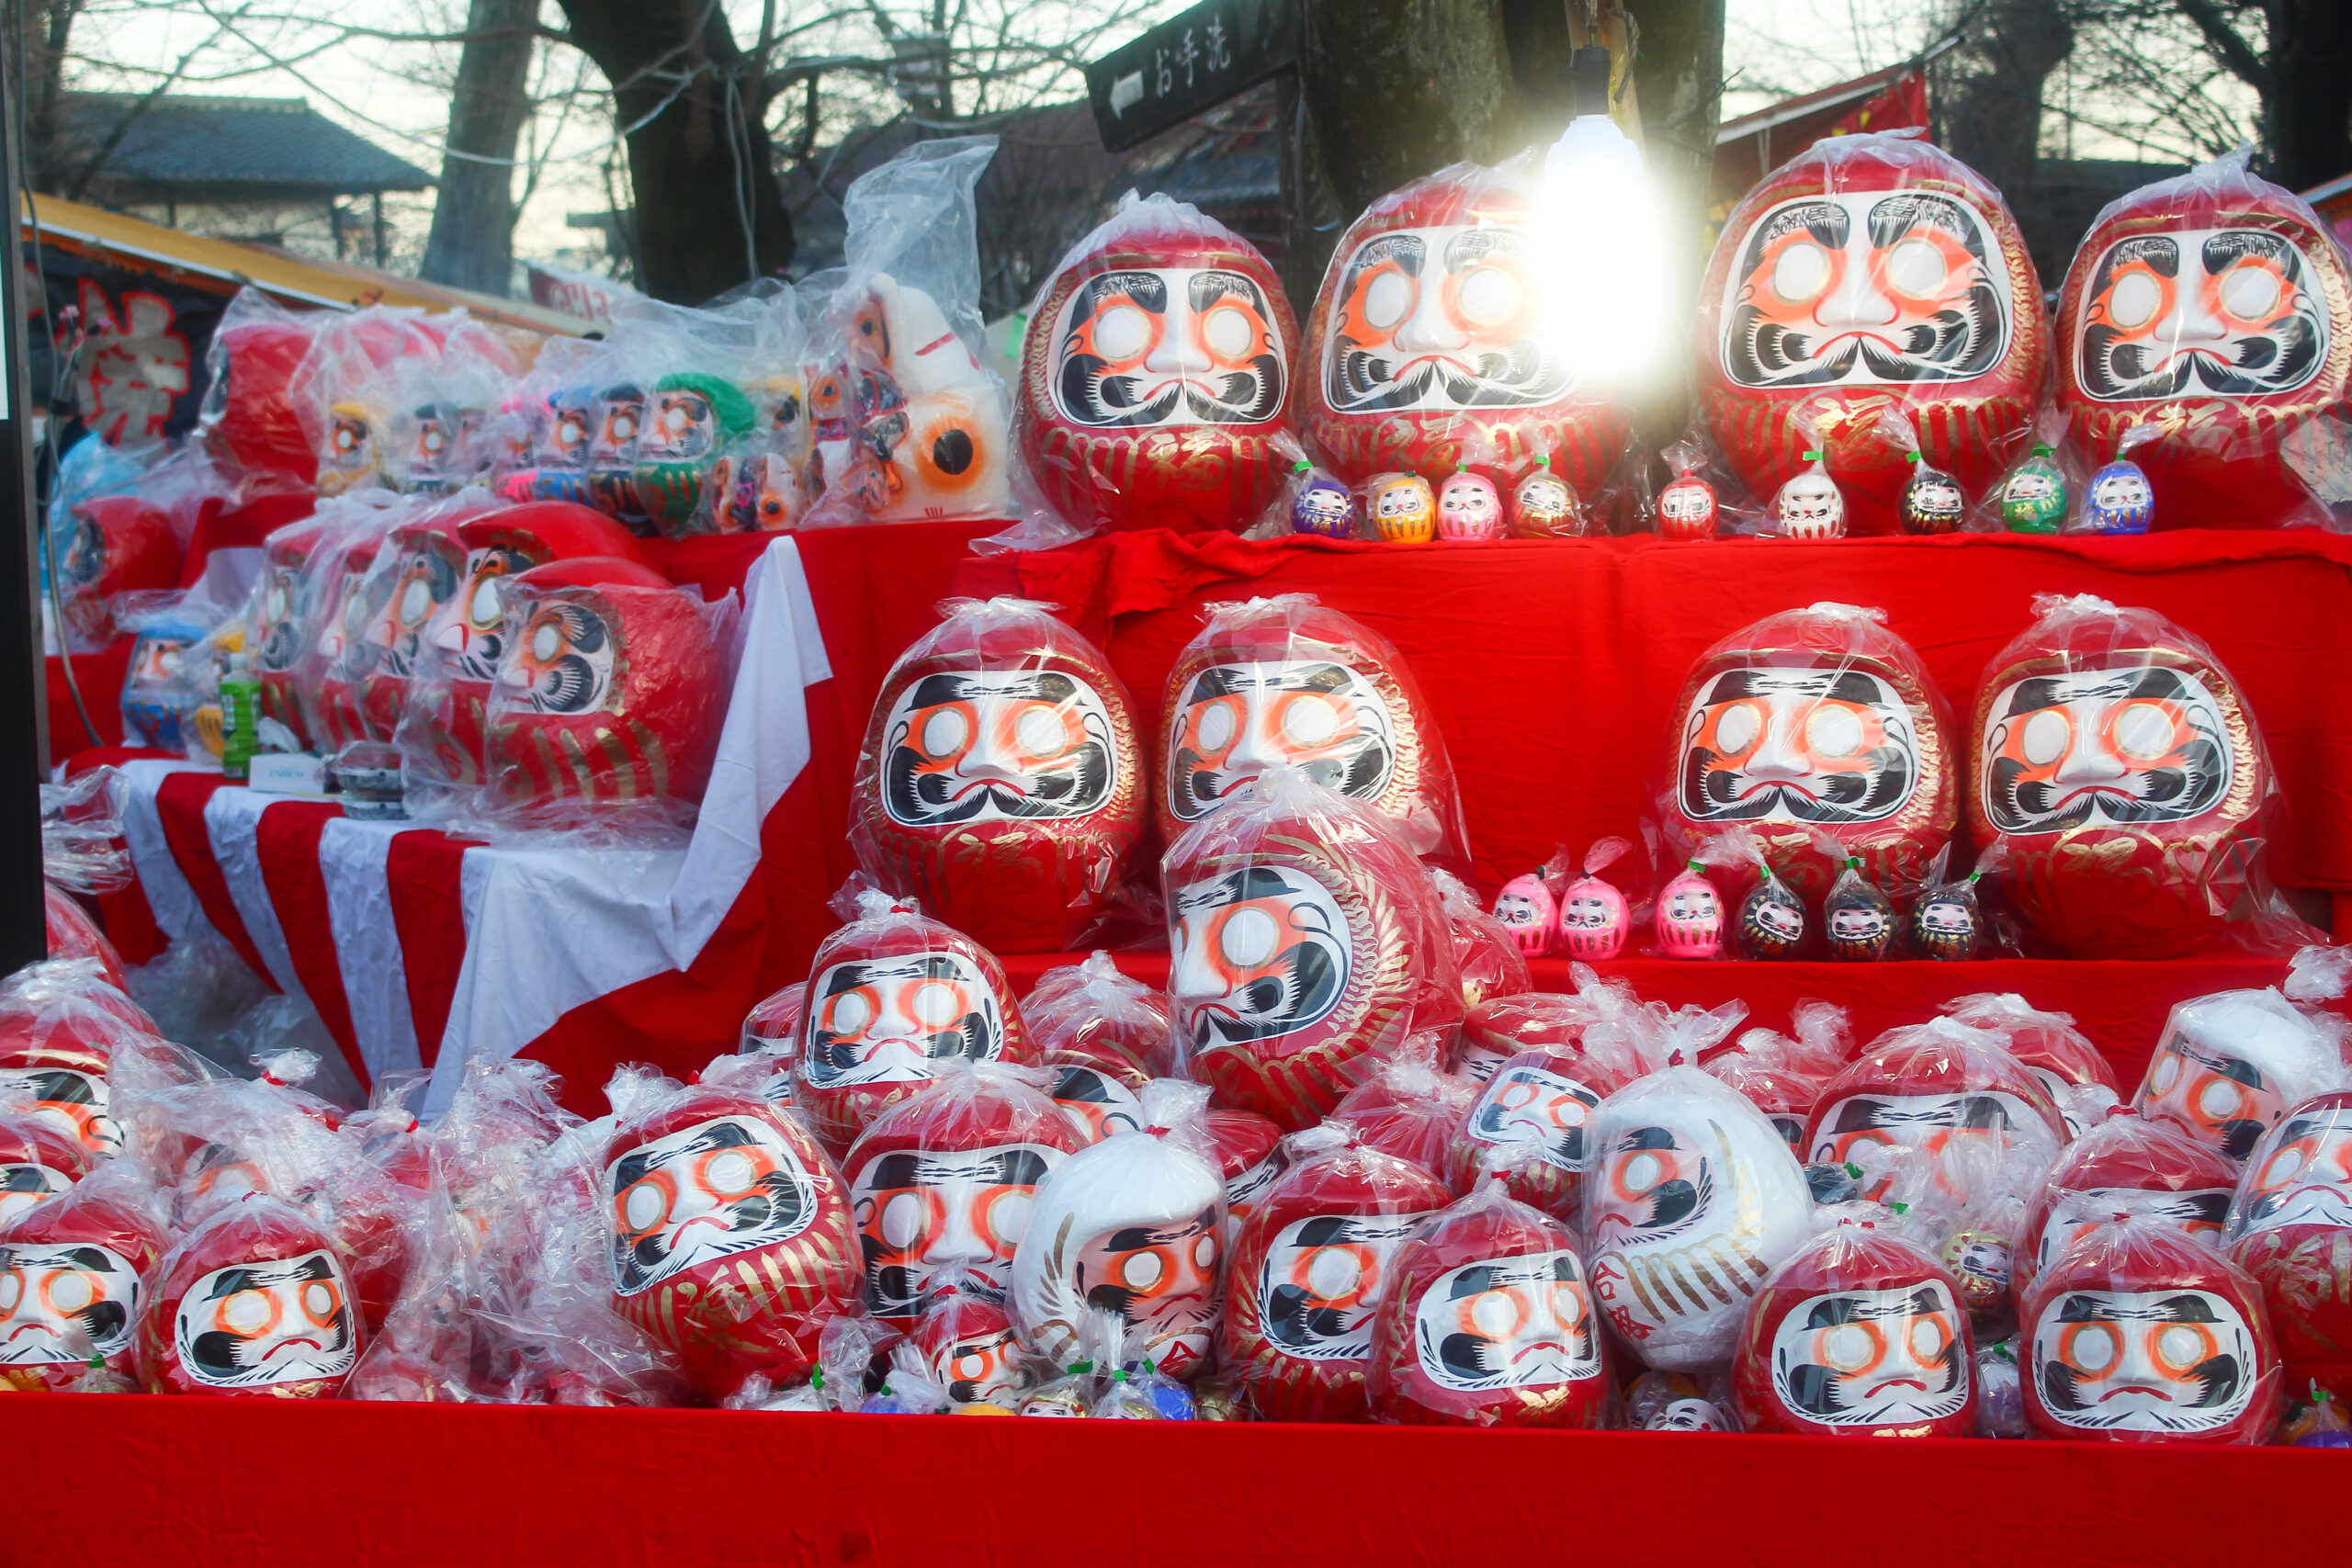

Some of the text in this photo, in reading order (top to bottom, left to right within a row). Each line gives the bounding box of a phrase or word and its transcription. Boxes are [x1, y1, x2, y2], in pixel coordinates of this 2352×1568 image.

[1155, 15, 1231, 98] お手洗
[1146, 428, 1227, 491] 福
[1592, 1261, 1657, 1342] 合格
